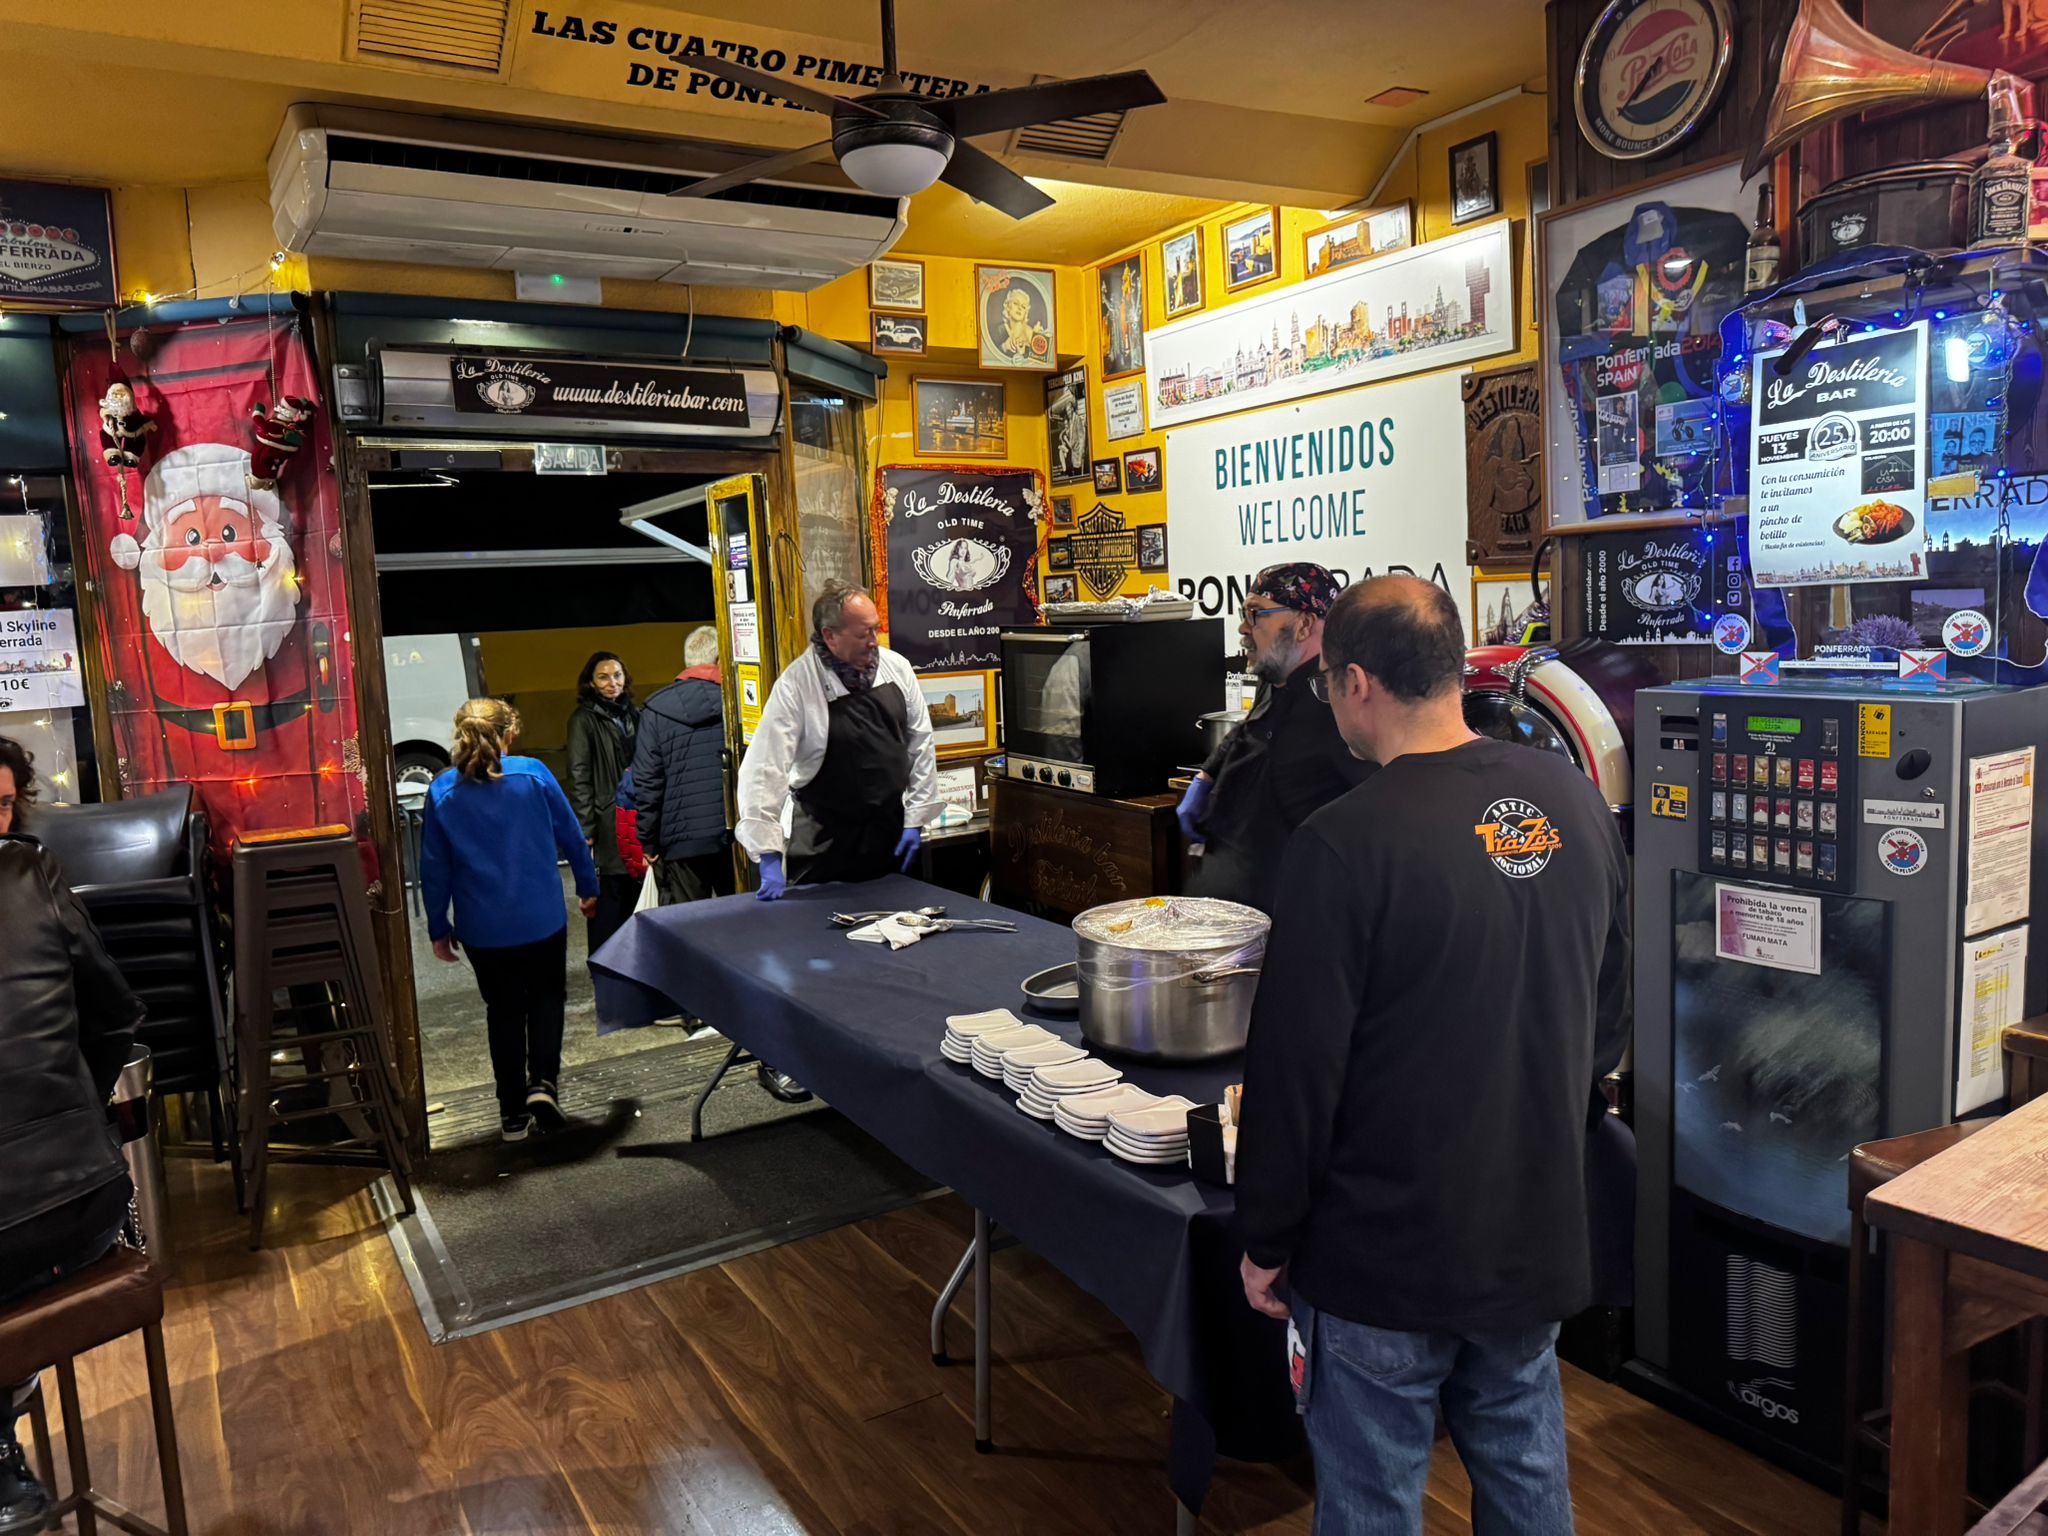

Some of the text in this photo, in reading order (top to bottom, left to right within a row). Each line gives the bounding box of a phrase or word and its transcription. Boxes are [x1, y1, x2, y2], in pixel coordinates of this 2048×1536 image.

[532, 11, 617, 45] LAS
[627, 27, 786, 72] CUATRO
[626, 62, 679, 91] DE
[1594, 117, 1614, 143] MORE
[1615, 138, 1653, 150] BOUNCE
[0, 245, 85, 262] FERRADA
[13, 262, 52, 271] BIERZO
[456, 358, 551, 385] La Destileria
[1596, 366, 1639, 388] SPAIN
[1767, 356, 1907, 409] La Destileria
[553, 379, 745, 412] www.destileriabar.com
[1816, 387, 1857, 403] BAR
[1760, 431, 1799, 444] JUEVES
[1869, 426, 1911, 444] 20:00
[1216, 417, 1395, 490] BIENVENIDOS
[1771, 442, 1788, 455] 13
[1810, 444, 1856, 460] ANIVERSARIO
[542, 446, 601, 471] SALIDA
[1760, 452, 1799, 463] NOVIEMBRE
[1761, 466, 1845, 486] Con tu consumición
[903, 482, 1015, 518] La Destileria
[1760, 486, 1813, 499] te invitamos
[1760, 504, 1779, 513] a un
[937, 517, 985, 530] OLD TIME
[1239, 489, 1366, 546] WELCOME
[1759, 514, 1803, 529] pincho de
[1760, 530, 1787, 541] botillo
[1617, 550, 1643, 571] La
[1641, 560, 1680, 570] OLD TIME
[1598, 550, 1607, 632] Desde el año 2000
[937, 599, 994, 620] Ponferrada
[6, 619, 57, 636] Skyline
[928, 625, 1001, 638] DESDE EL AÑO 200
[1814, 644, 1872, 654] PONFERRADA
[1, 678, 30, 692] 10€
[1491, 801, 1535, 819] ARTIC
[1727, 895, 1808, 914] Prohibida la venta
[1758, 908, 1783, 917] tabaco
[1735, 911, 1764, 920] menores
[1786, 917, 1804, 927] años
[1742, 933, 1788, 947] FUMAR MATA
[1742, 1389, 1799, 1424] argos
